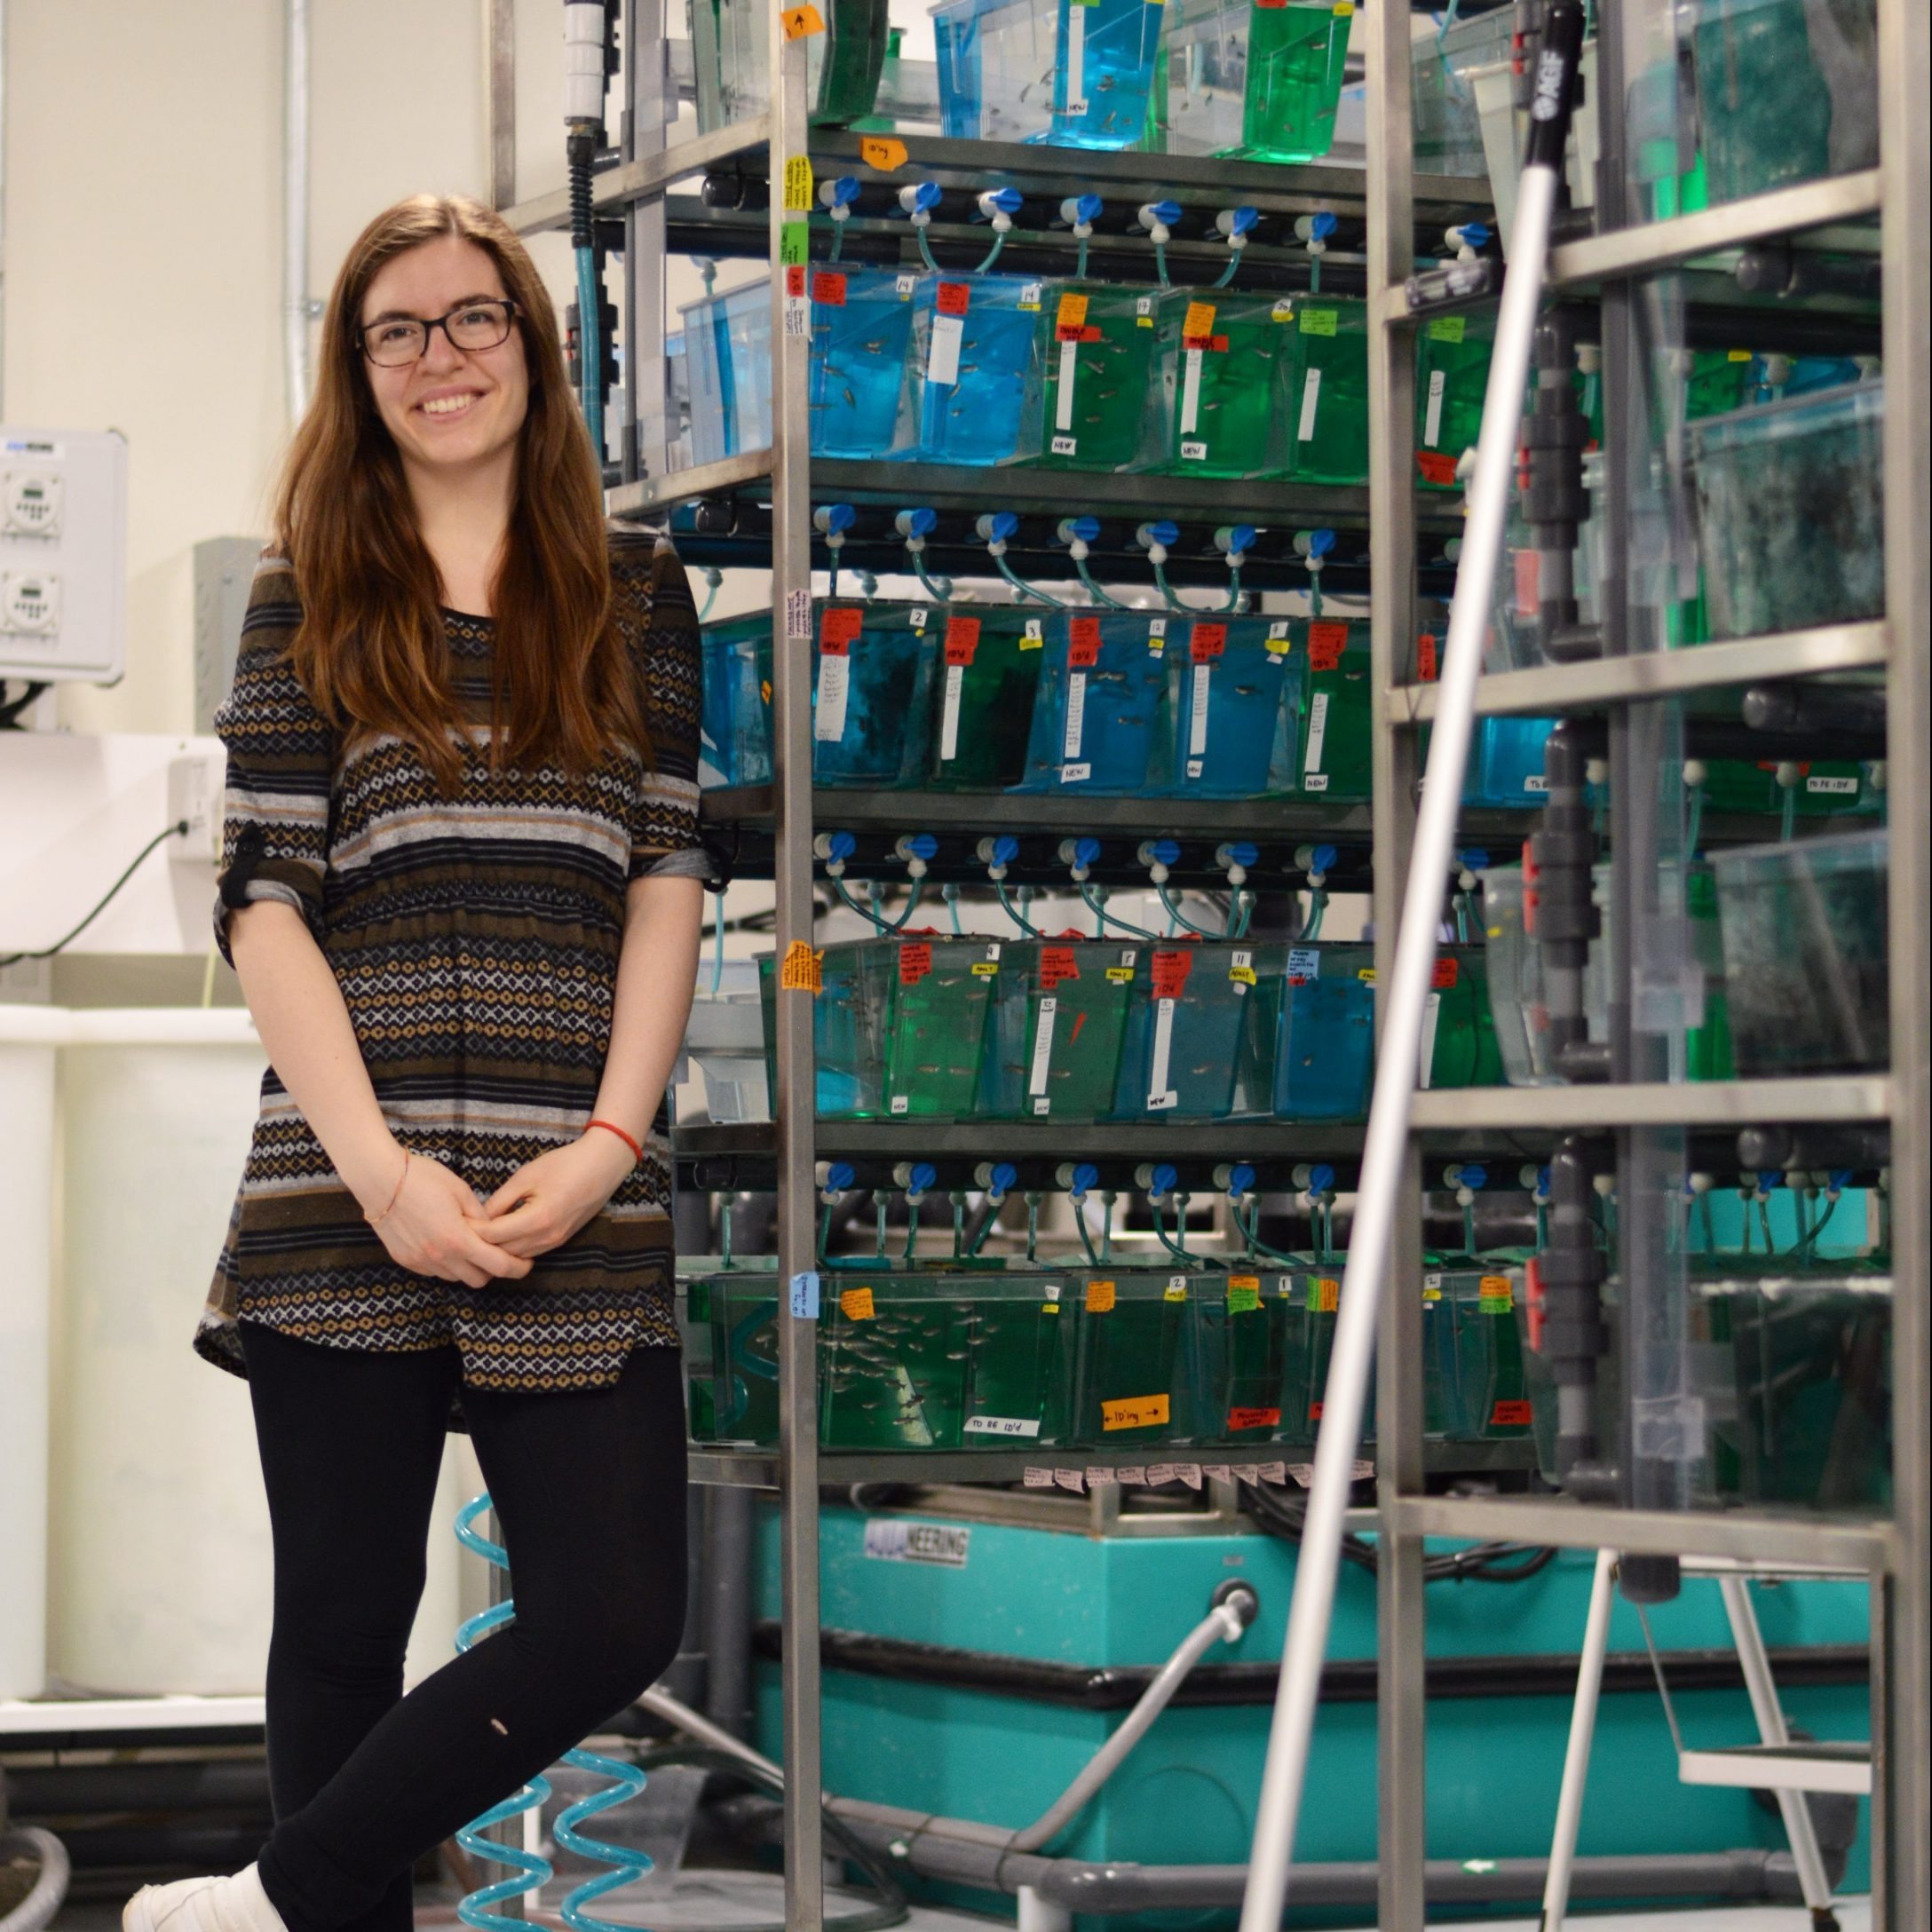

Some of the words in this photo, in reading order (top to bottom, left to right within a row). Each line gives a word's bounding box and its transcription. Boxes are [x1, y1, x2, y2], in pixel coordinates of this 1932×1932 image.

[1537, 50, 1564, 99] AGF
[898, 280, 909, 290] 14
[1024, 290, 1034, 301] 14
[1183, 447, 1200, 455] NEW
[915, 612, 922, 622] 2
[1029, 627, 1036, 637] 3
[1065, 768, 1083, 778] NEW
[1237, 954, 1244, 964] 11
[1174, 1278, 1181, 1287] 2
